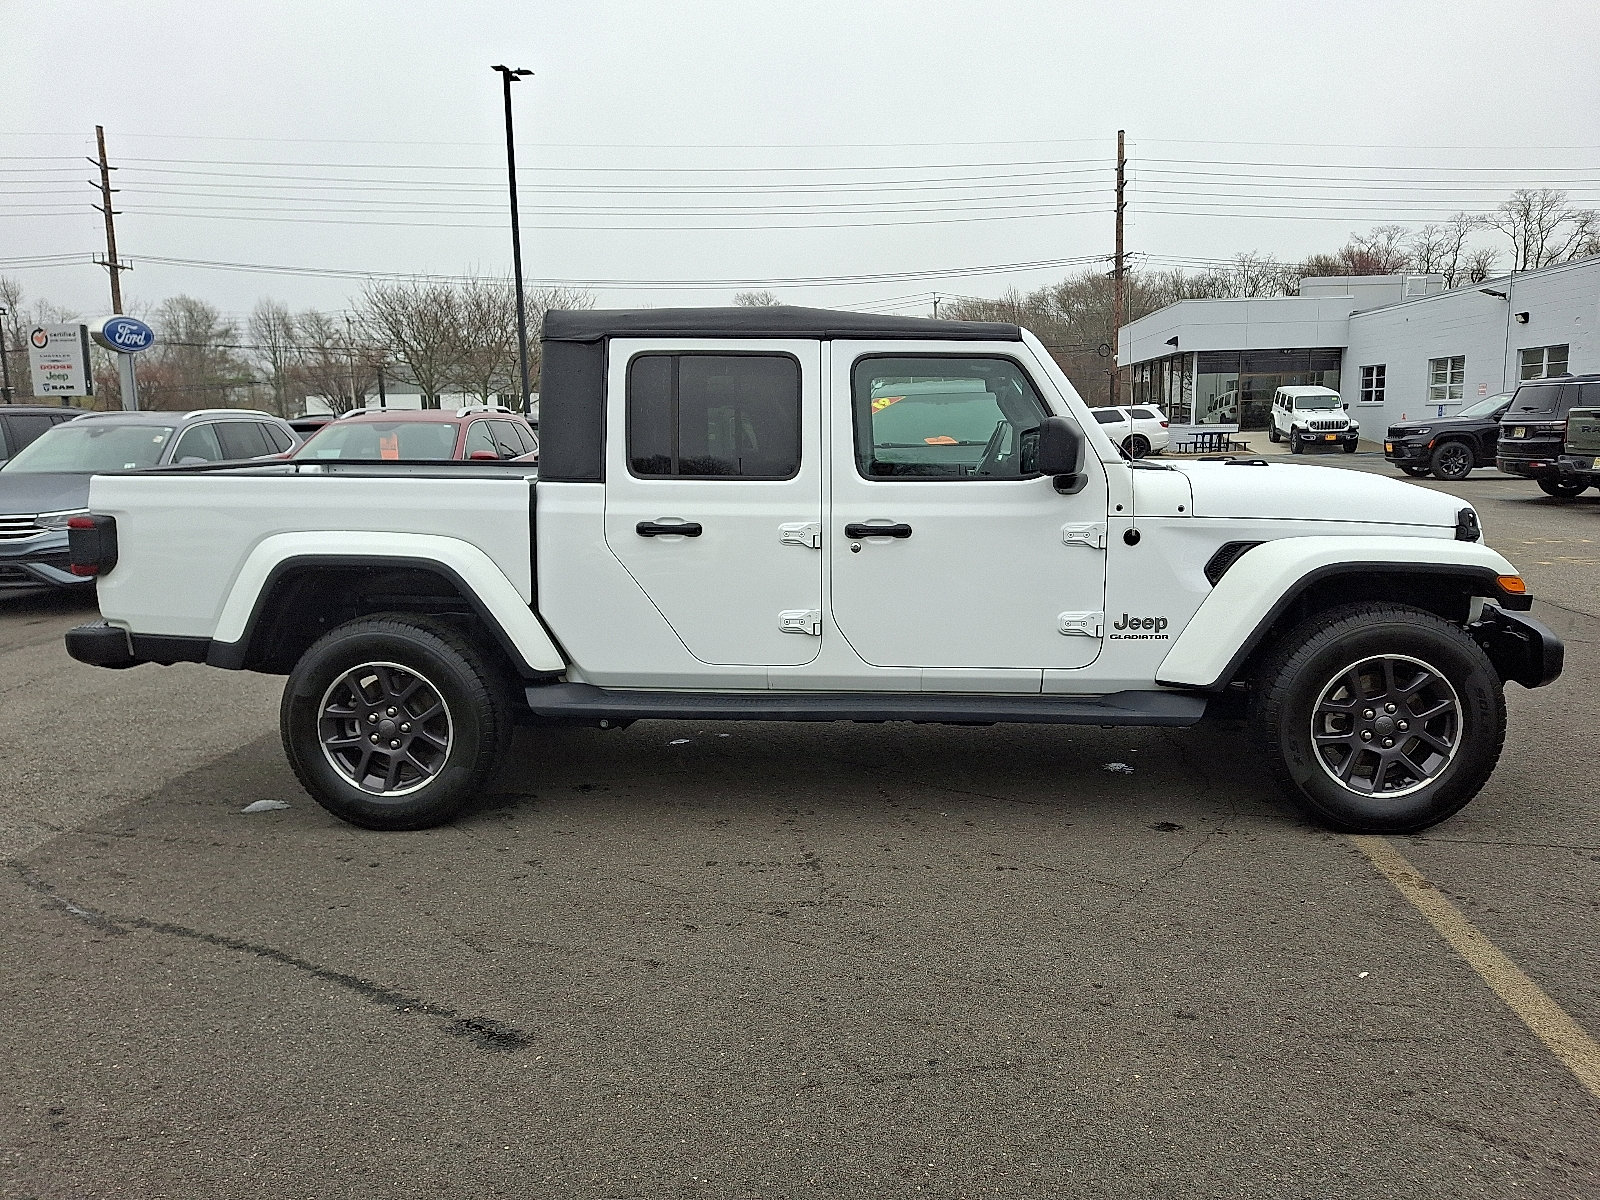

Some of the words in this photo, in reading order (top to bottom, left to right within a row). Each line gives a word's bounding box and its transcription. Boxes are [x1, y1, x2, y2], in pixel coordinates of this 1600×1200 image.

[114, 323, 146, 345] Ford
[45, 371, 68, 381] Jeep
[1113, 612, 1168, 633] Jeep
